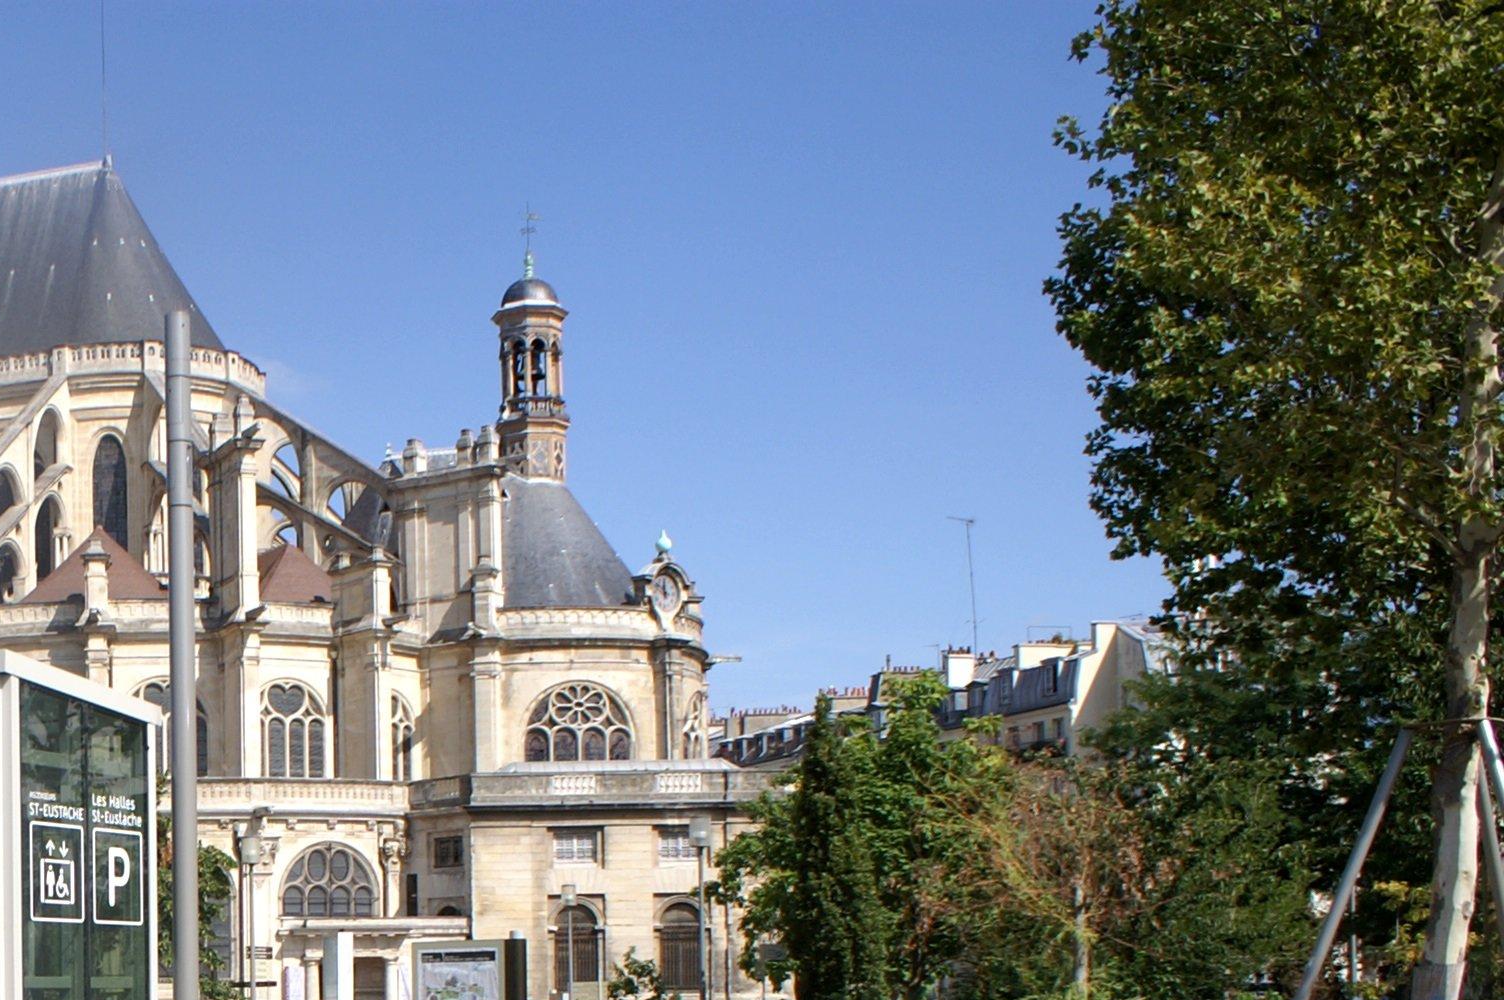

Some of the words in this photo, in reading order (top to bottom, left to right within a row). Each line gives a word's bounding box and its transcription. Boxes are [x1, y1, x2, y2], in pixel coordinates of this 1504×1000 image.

[92, 793, 107, 807] Les
[109, 795, 136, 811] Halles
[29, 802, 84, 821] ST-EUSTACHE
[92, 809, 142, 827] St-Eustache
[108, 846, 131, 907] P
